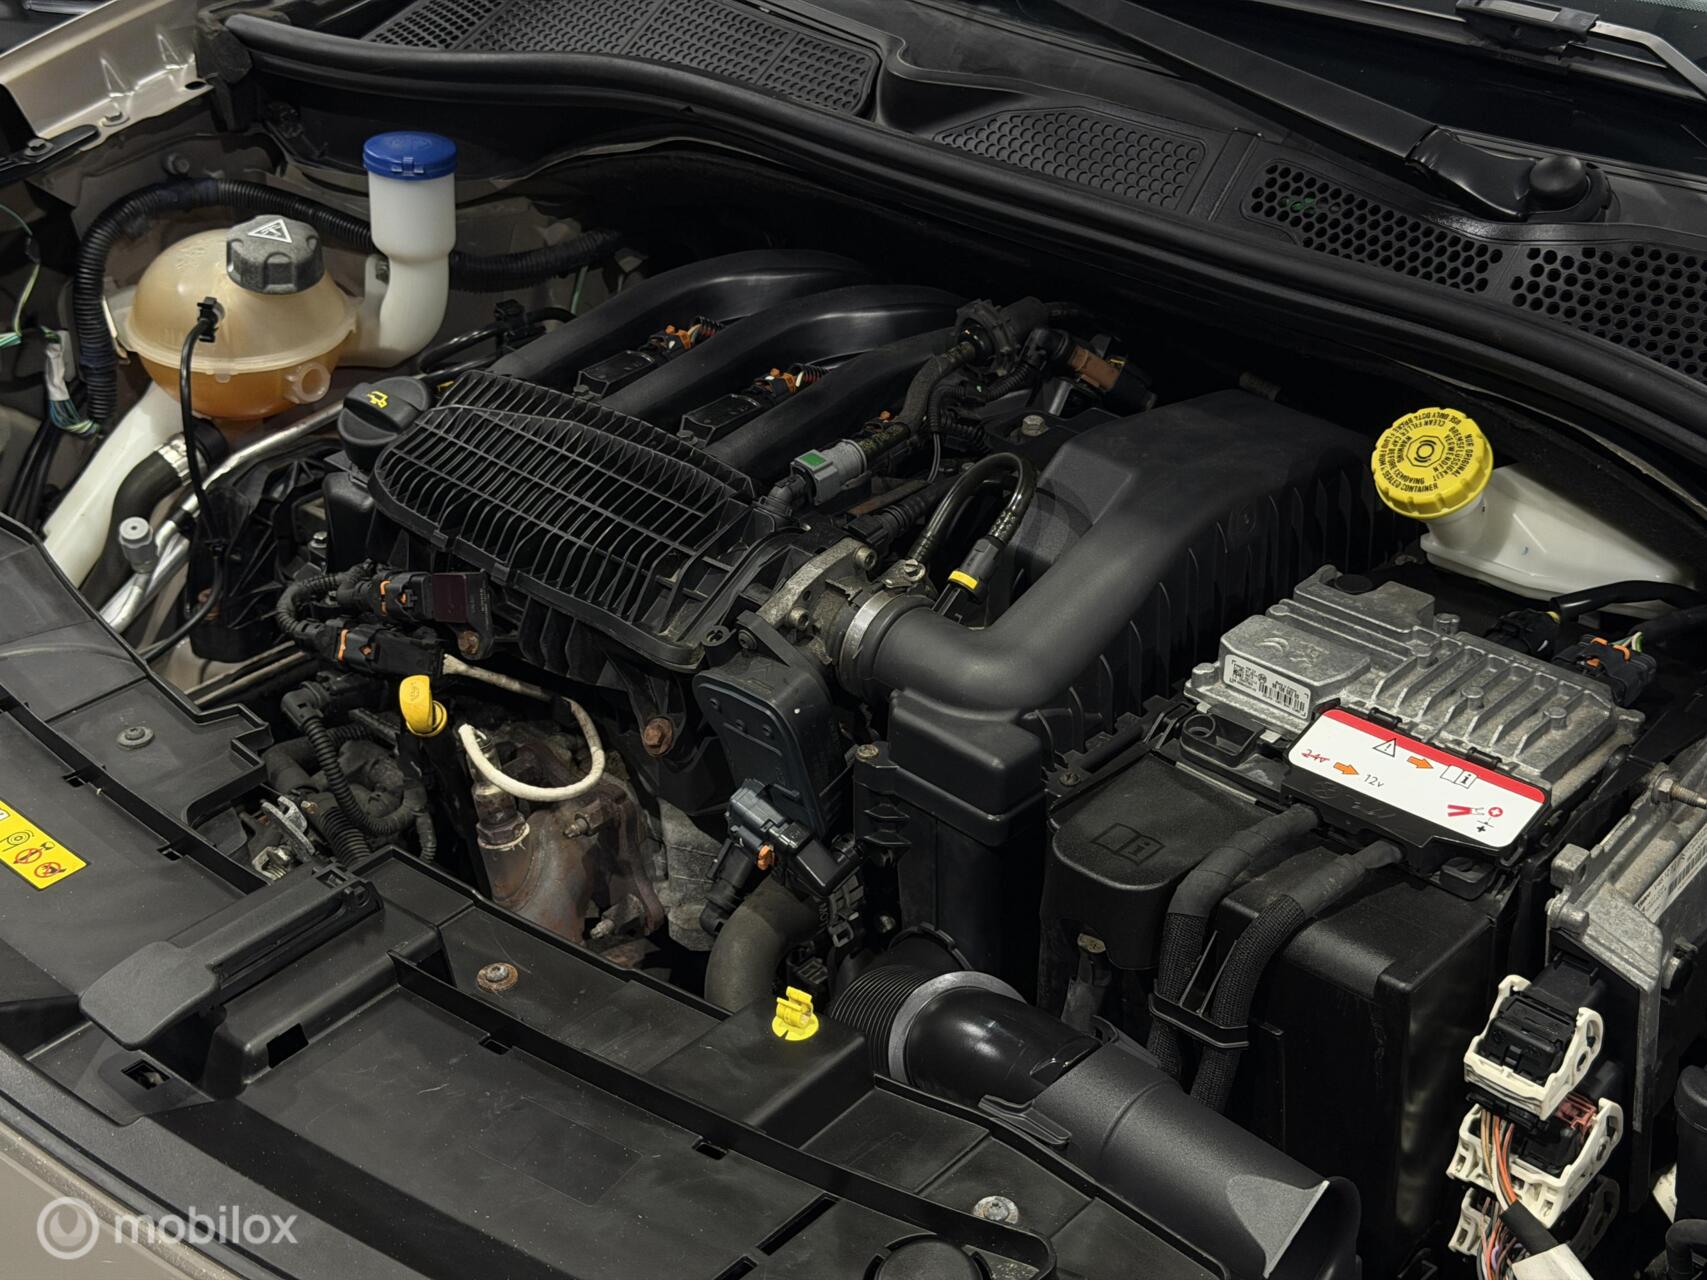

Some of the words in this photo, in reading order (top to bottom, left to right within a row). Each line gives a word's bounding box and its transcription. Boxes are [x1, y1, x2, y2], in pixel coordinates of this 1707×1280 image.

[1424, 419, 1446, 428] CLEAN
[1432, 412, 1450, 420] ONLY
[1449, 416, 1462, 425] USE
[1391, 417, 1414, 434] BRAKE
[1398, 420, 1423, 438] FILLER
[1380, 431, 1396, 449] FLUID
[1389, 435, 1403, 448] CAP
[1464, 433, 1474, 447] NUR
[1396, 434, 1413, 464] WARNING
[1433, 433, 1454, 474] VERWENDEN
[1379, 449, 1388, 467] FROM
[1387, 447, 1398, 471] BEFORE
[1452, 448, 1474, 478] ORIGINAL
[1382, 470, 1402, 488] SEALED
[1393, 468, 1424, 485] REMOVING
[1400, 482, 1438, 493] CONTAINER
